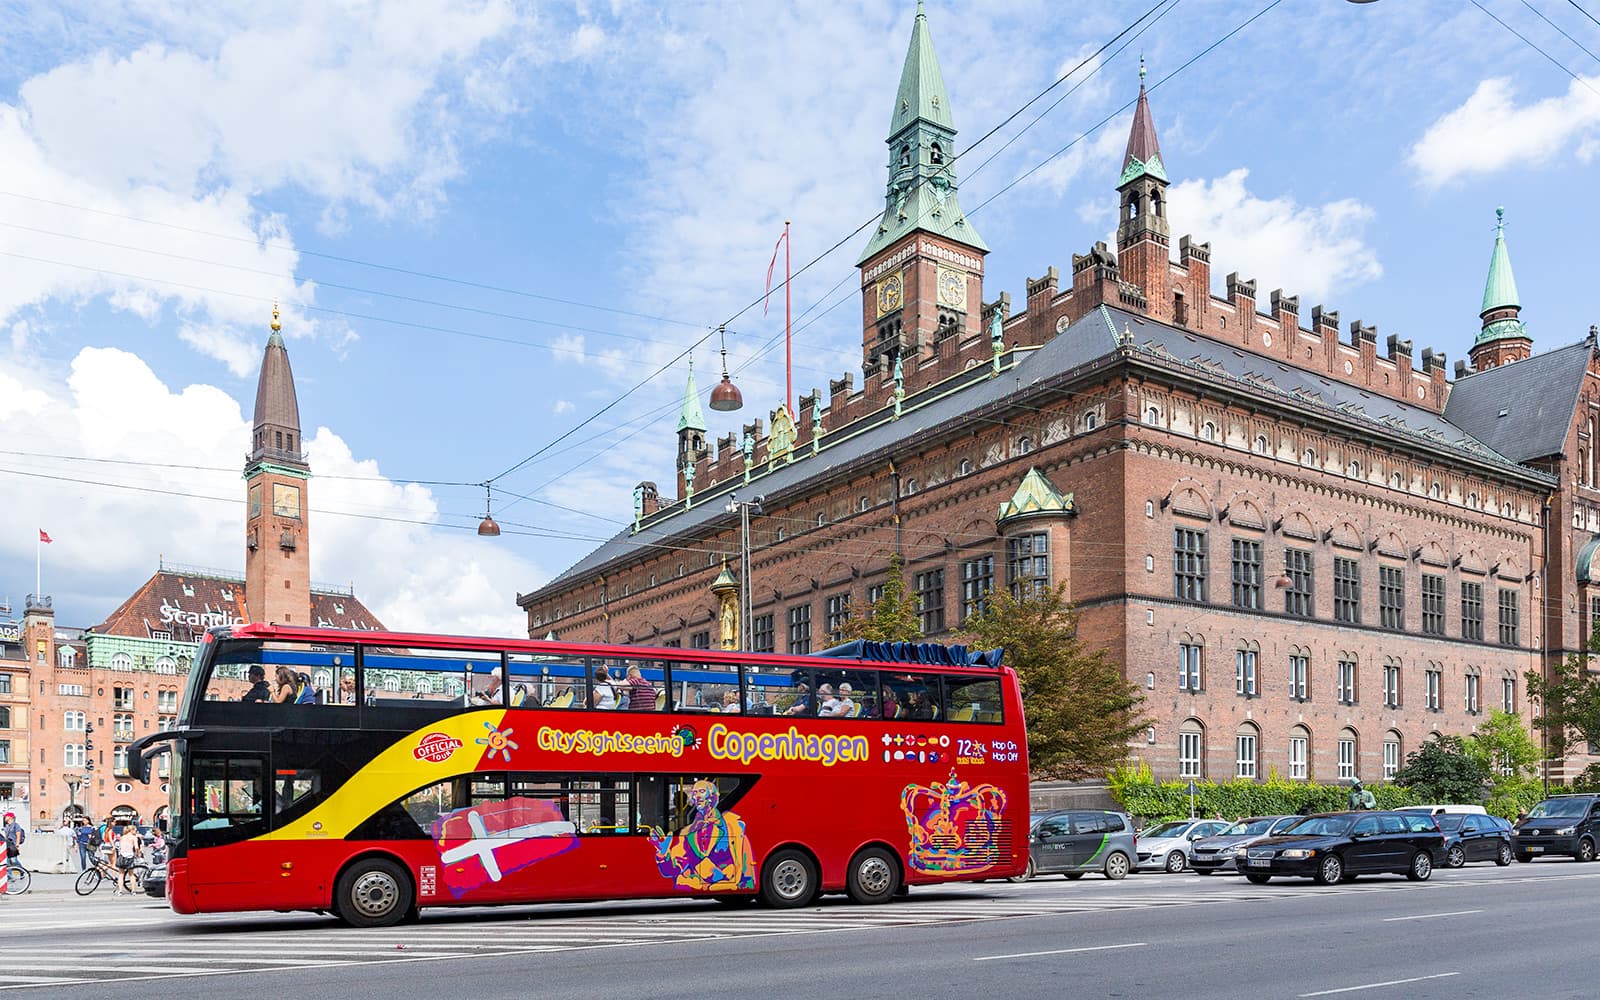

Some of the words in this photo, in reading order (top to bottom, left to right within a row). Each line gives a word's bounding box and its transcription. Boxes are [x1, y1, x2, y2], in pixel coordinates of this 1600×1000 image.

[160, 604, 245, 627] Scandic
[417, 739, 460, 757] OFFICIAL
[537, 726, 684, 758] CitySightseeing
[708, 723, 869, 766] Copenhagen
[957, 739, 972, 756] 72
[991, 740, 1006, 751] Hop
[1007, 740, 1017, 751] On
[431, 750, 452, 760] TOUR
[991, 752, 1006, 762] Hop
